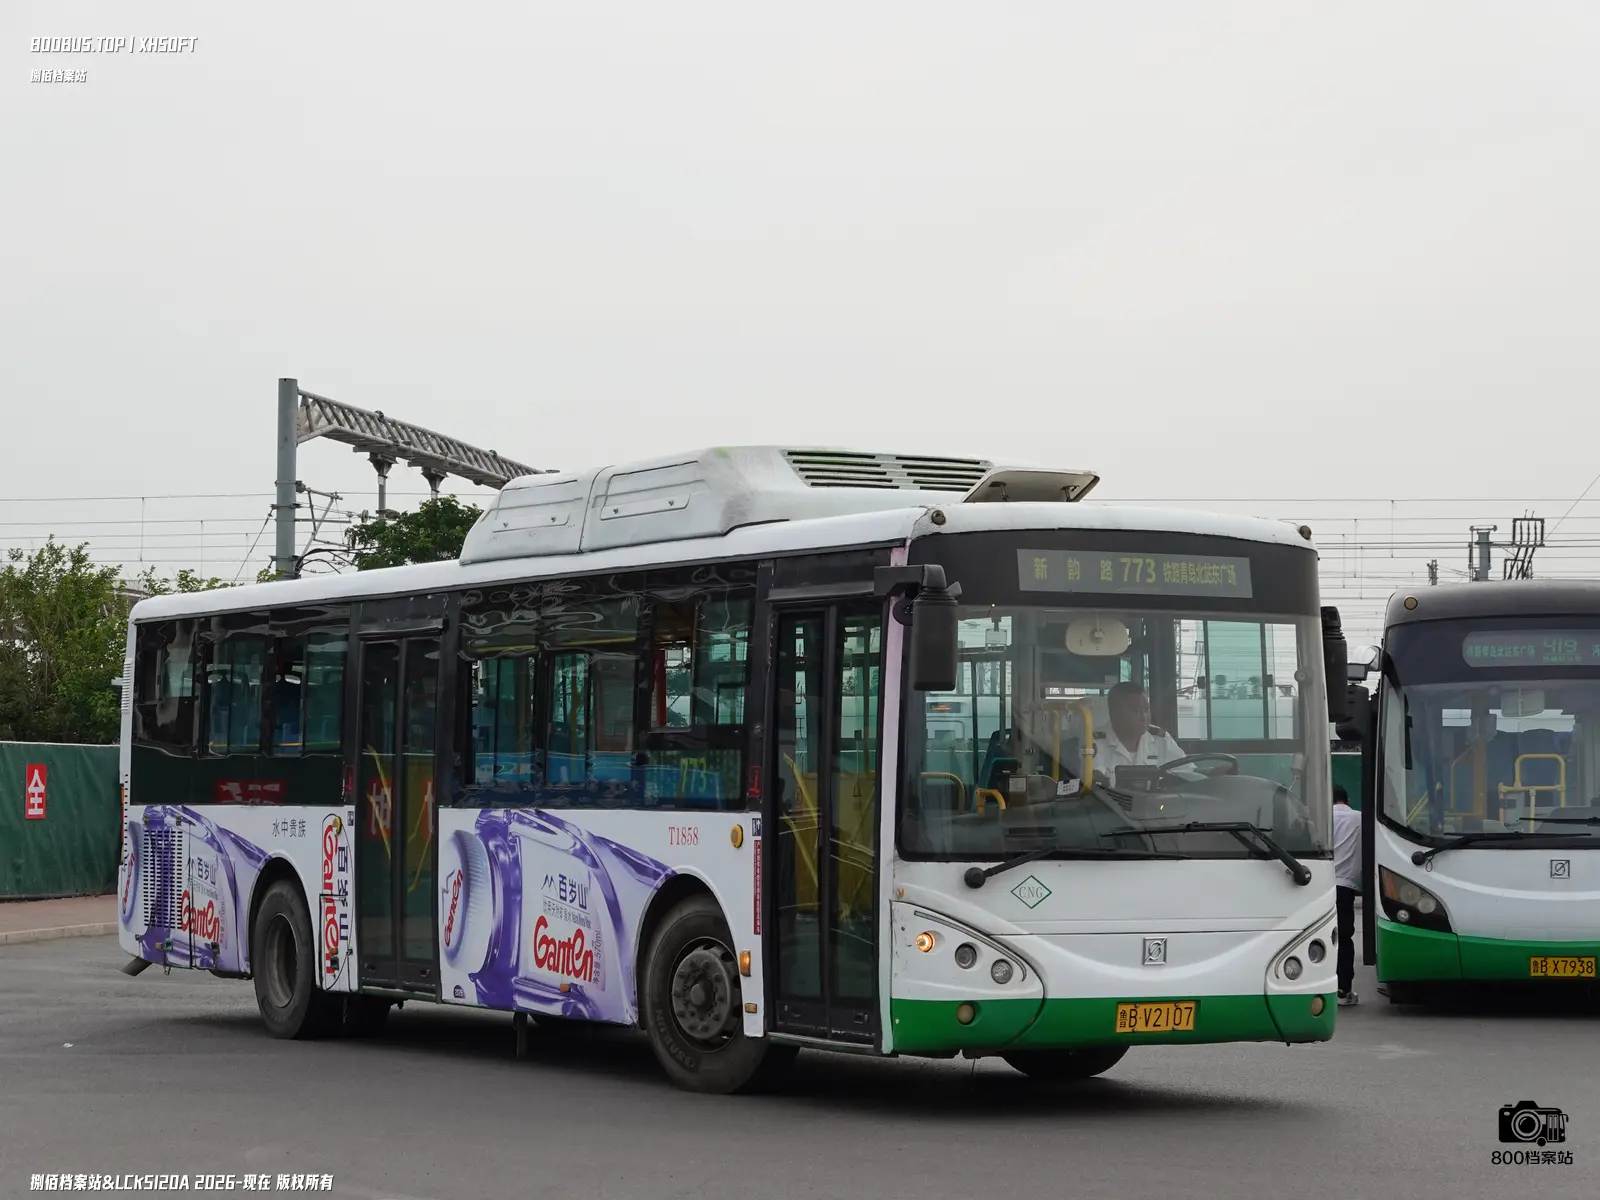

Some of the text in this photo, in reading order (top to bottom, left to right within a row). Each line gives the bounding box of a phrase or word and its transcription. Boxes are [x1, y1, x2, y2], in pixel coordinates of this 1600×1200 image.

[1119, 557, 1156, 584] 773
[1543, 636, 1578, 653] 419
[680, 757, 707, 794] 773
[272, 818, 306, 838] 水中贵族
[668, 826, 699, 846] T1858
[197, 856, 216, 886] 百岁山
[558, 873, 588, 910] 百岁山
[1018, 886, 1043, 899] CNG
[181, 889, 220, 944] Ganten
[533, 914, 594, 983] Ganten
